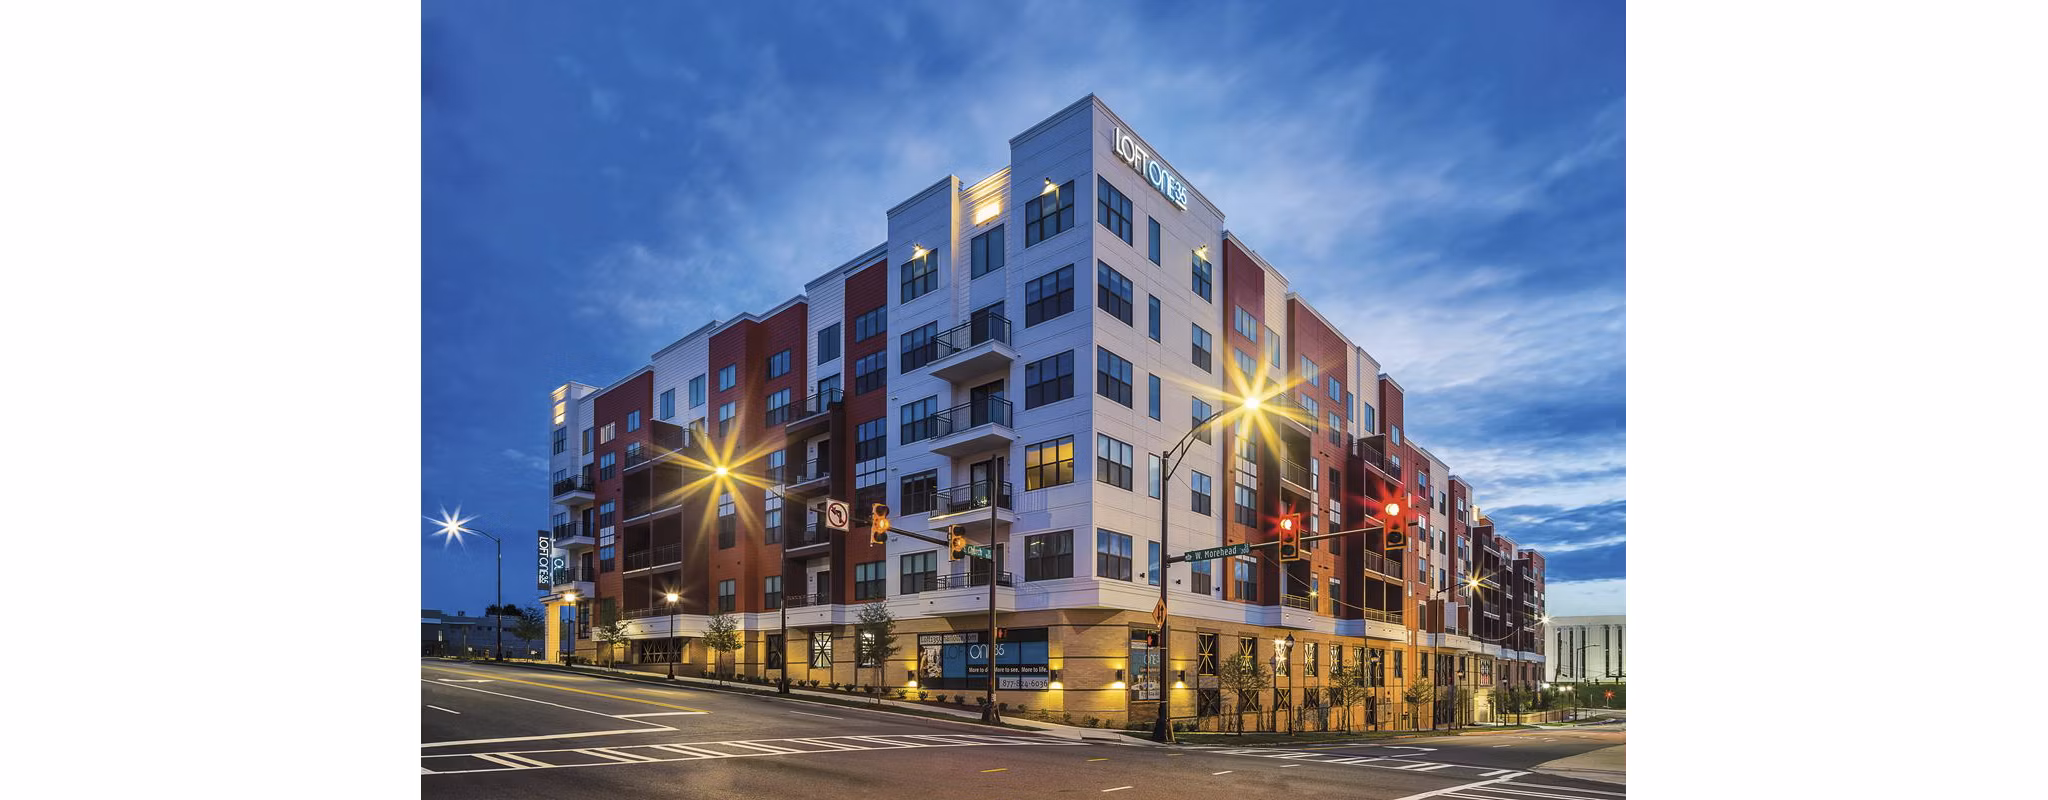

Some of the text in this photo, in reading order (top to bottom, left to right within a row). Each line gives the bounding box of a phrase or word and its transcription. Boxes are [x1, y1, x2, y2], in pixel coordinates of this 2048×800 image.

[1115, 127, 1149, 175] LOFT
[539, 536, 549, 558] LOFT
[1204, 545, 1237, 559] Morehead
